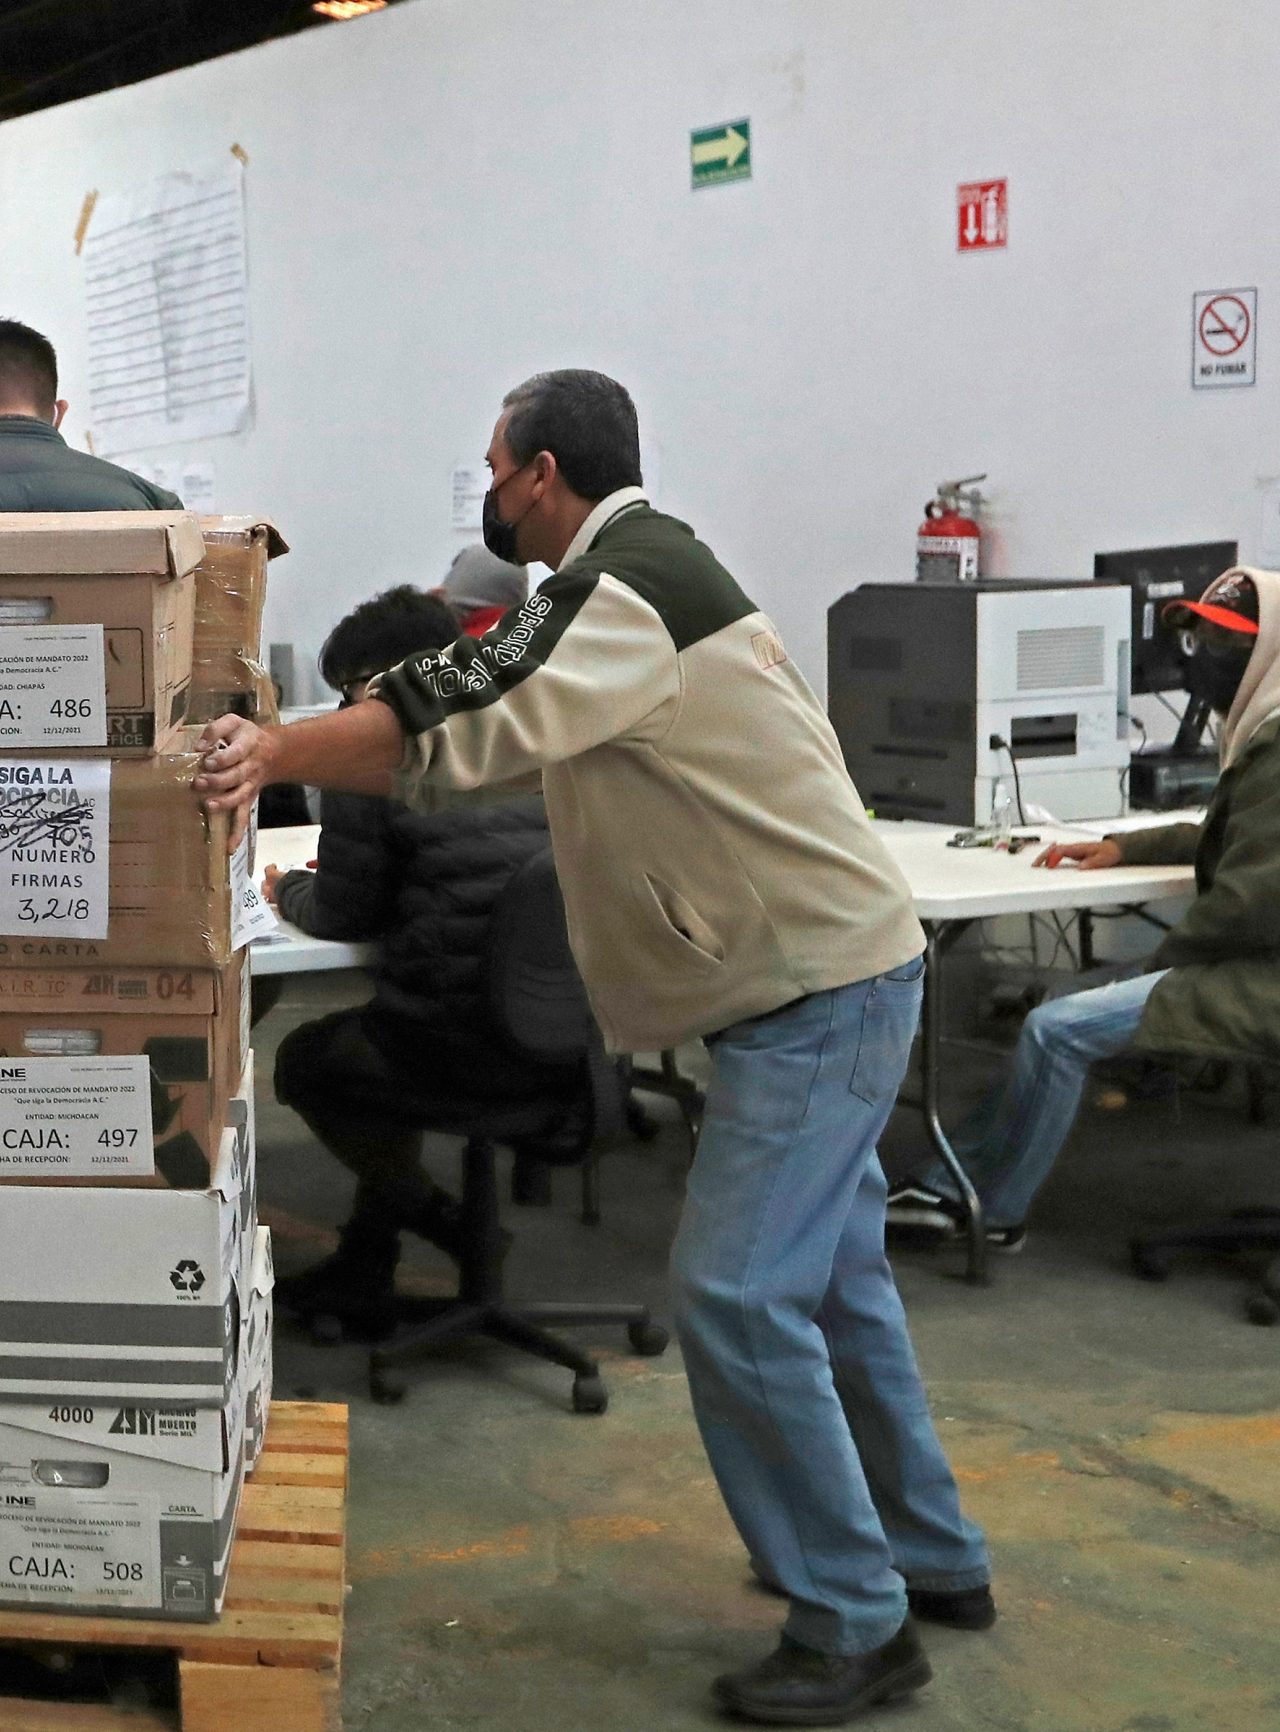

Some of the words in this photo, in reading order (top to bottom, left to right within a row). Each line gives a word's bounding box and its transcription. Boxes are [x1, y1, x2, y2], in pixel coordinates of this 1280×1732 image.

[50, 699, 92, 718] 486
[107, 735, 143, 745] FFICE
[48, 767, 73, 785] LA
[12, 849, 96, 863] NUMERO
[12, 874, 83, 888] FIRMAS
[18, 899, 89, 921] 3,218
[22, 943, 100, 957] CARTA
[157, 973, 195, 1000] 04
[3, 1129, 69, 1149] CAJA:
[98, 1129, 138, 1148] 497
[49, 1406, 94, 1424] 4000
[158, 1420, 197, 1430] MUERTO
[6, 1496, 35, 1505] INE
[169, 1505, 197, 1514] CARTA
[9, 1556, 74, 1578] CAJA:
[103, 1562, 142, 1580] 508
